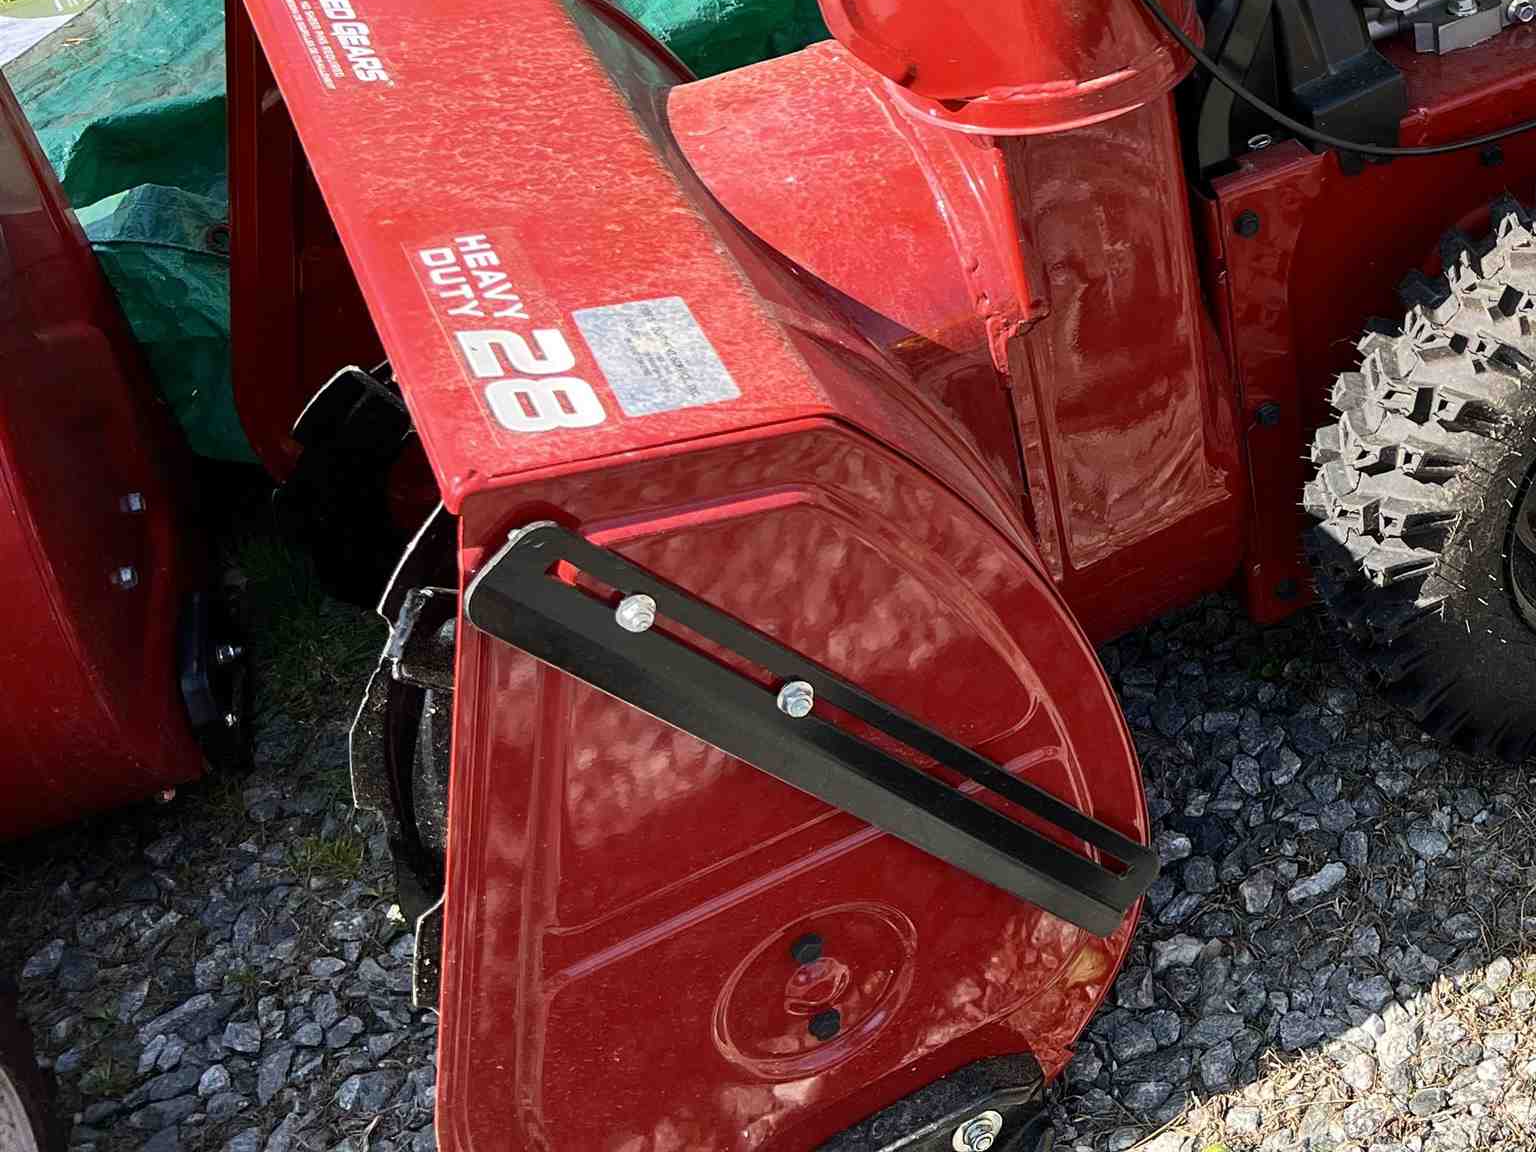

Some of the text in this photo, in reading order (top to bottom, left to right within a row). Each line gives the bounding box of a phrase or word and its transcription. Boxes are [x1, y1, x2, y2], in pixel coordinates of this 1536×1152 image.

[331, 21, 391, 82] GEARS
[419, 247, 485, 317] DUTY
[454, 234, 529, 319] HEAVY
[454, 328, 608, 432] 28
